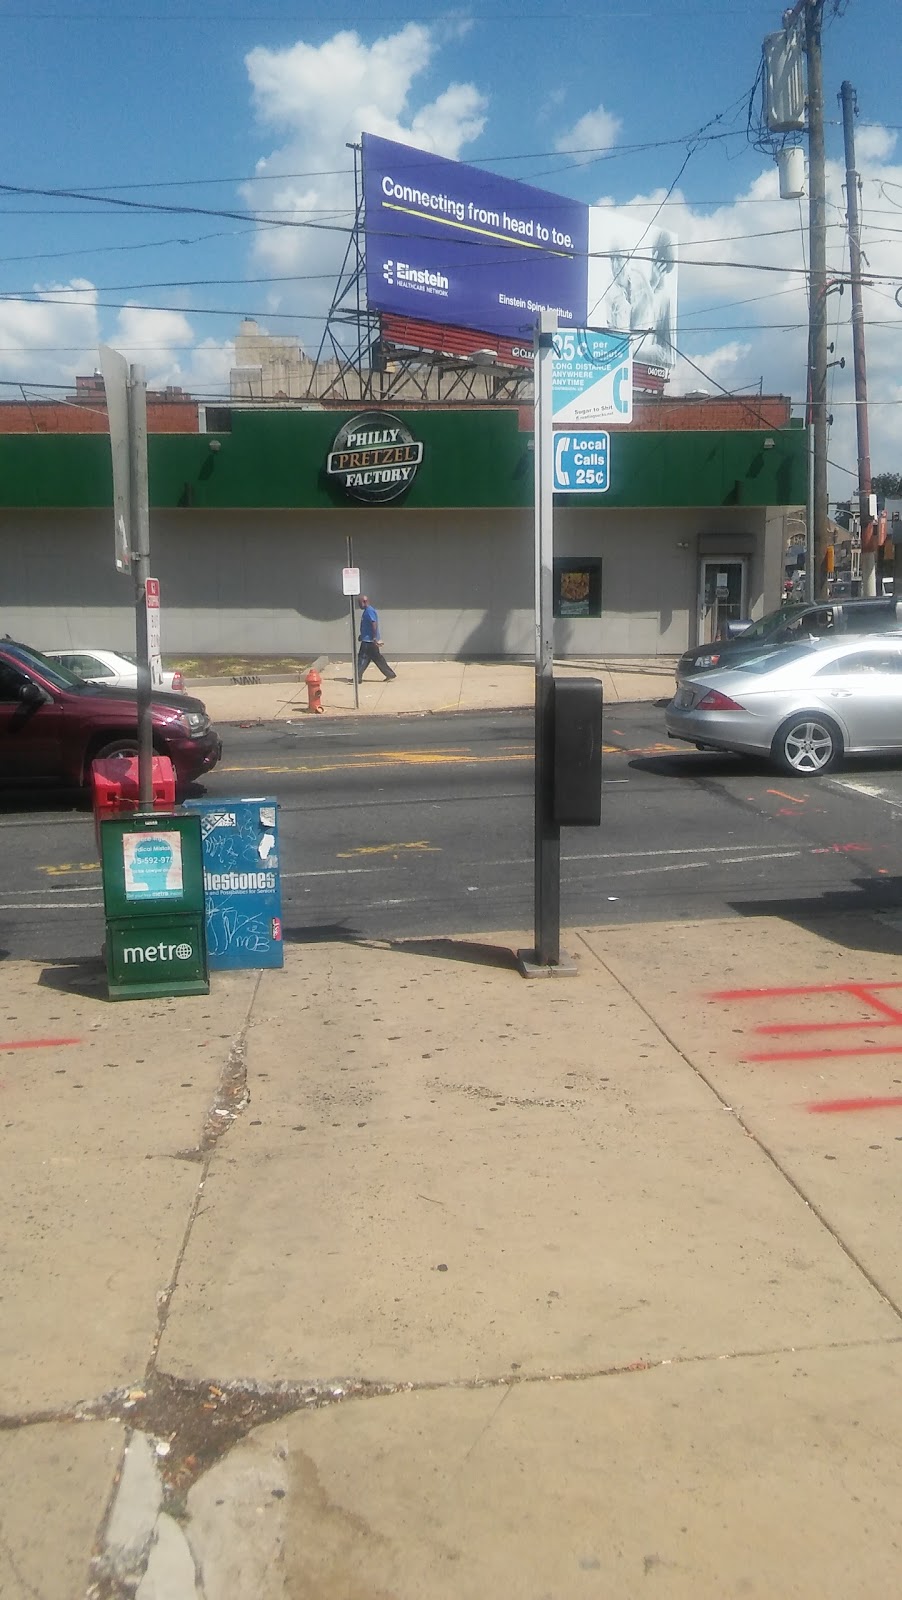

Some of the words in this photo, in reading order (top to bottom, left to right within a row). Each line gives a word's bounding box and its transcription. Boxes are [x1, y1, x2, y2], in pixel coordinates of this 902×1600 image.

[381, 176, 464, 220] Connecting
[468, 202, 499, 227] from
[503, 212, 533, 236] head
[537, 223, 549, 240] to
[552, 228, 574, 248] toe.
[396, 262, 449, 289] Einstein
[396, 280, 425, 292] HEALTHCARE
[426, 286, 449, 297] NETWORK
[499, 293, 526, 308] Einstein
[527, 299, 546, 312] Spine
[593, 341, 608, 349] per
[552, 362, 573, 370] LONG
[575, 362, 613, 371] DISTANCE
[346, 428, 400, 447] PHILLY
[573, 438, 606, 450] Local
[338, 446, 414, 469] PRETZEL
[574, 453, 605, 466] Calls
[345, 467, 412, 487] FACTORY
[575, 469, 604, 486] 25¢
[133, 856, 173, 865] 15-592-97
[203, 871, 275, 890] ilestones
[123, 942, 193, 963] metro
